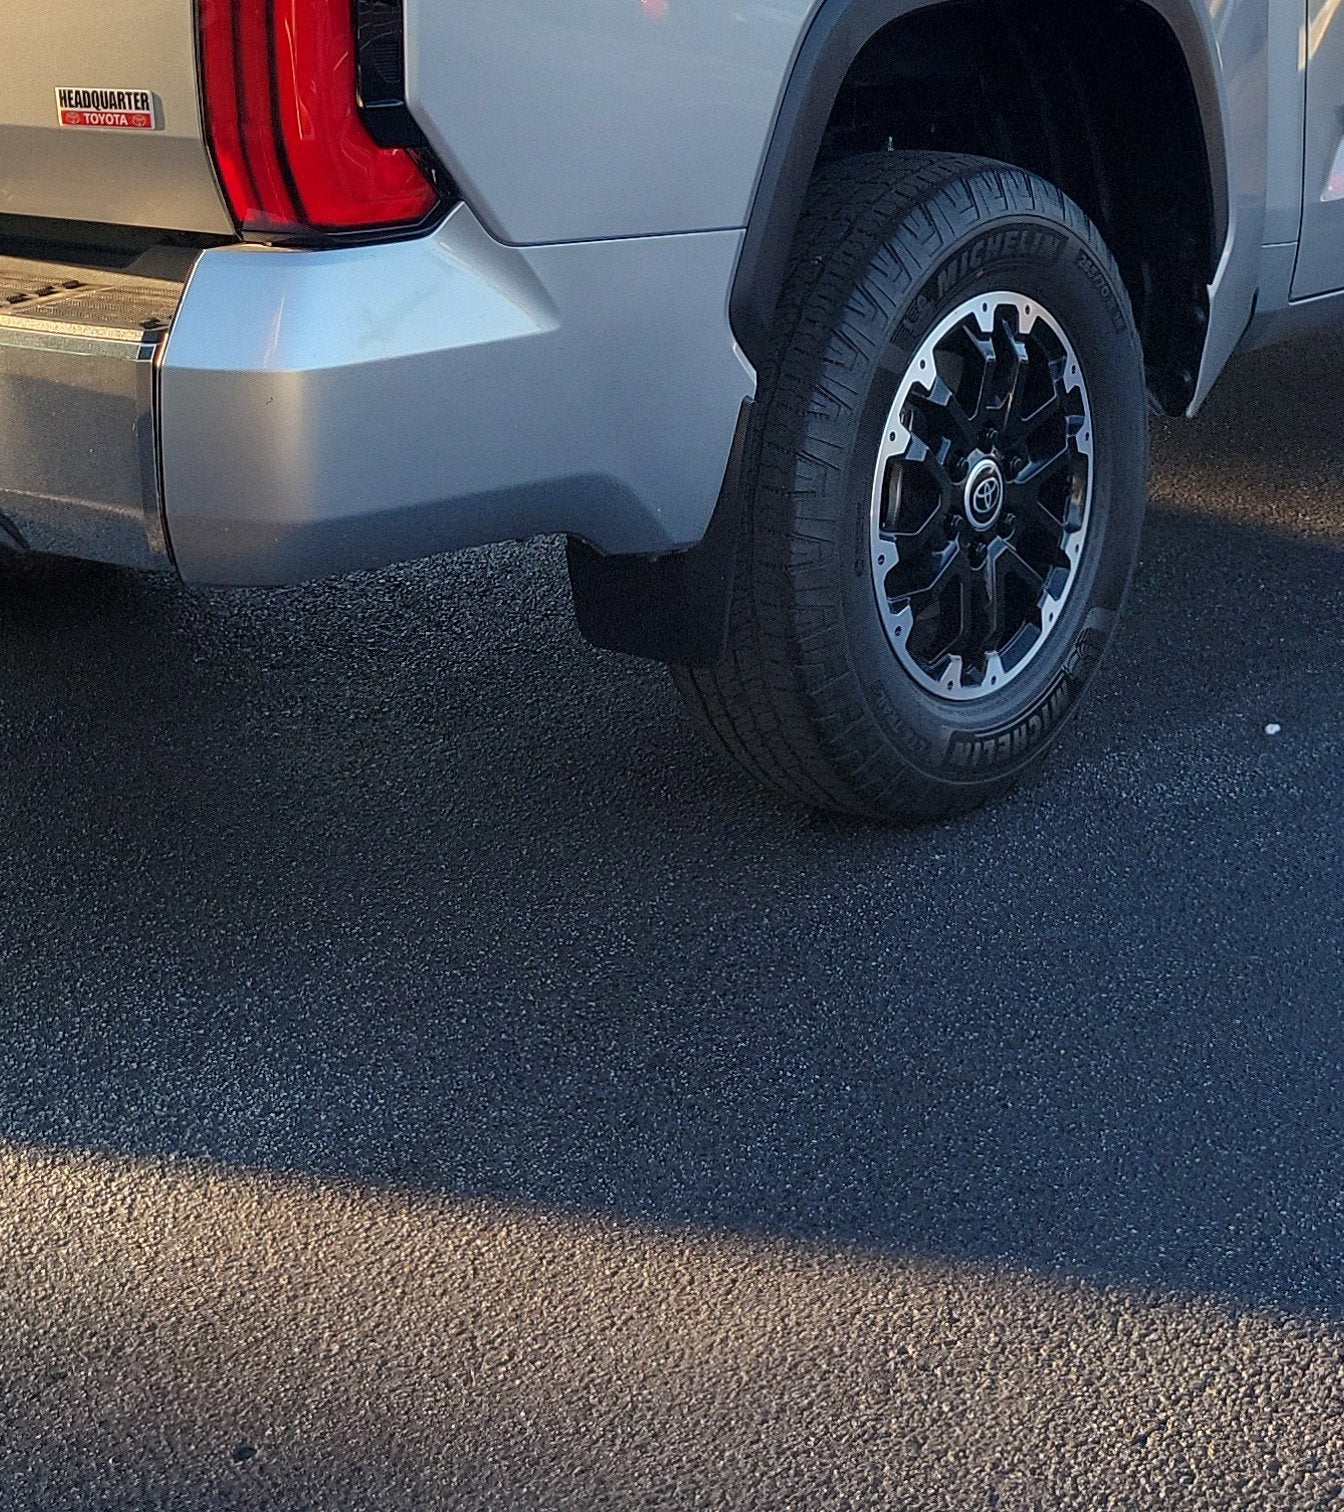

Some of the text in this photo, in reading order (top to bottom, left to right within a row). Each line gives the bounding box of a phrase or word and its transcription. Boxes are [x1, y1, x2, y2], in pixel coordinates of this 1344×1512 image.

[59, 89, 150, 111] HEADQUARTER
[83, 113, 128, 125] TOYOTA
[937, 230, 1067, 299] MICHELIN
[951, 678, 1069, 769] MICHELIN
